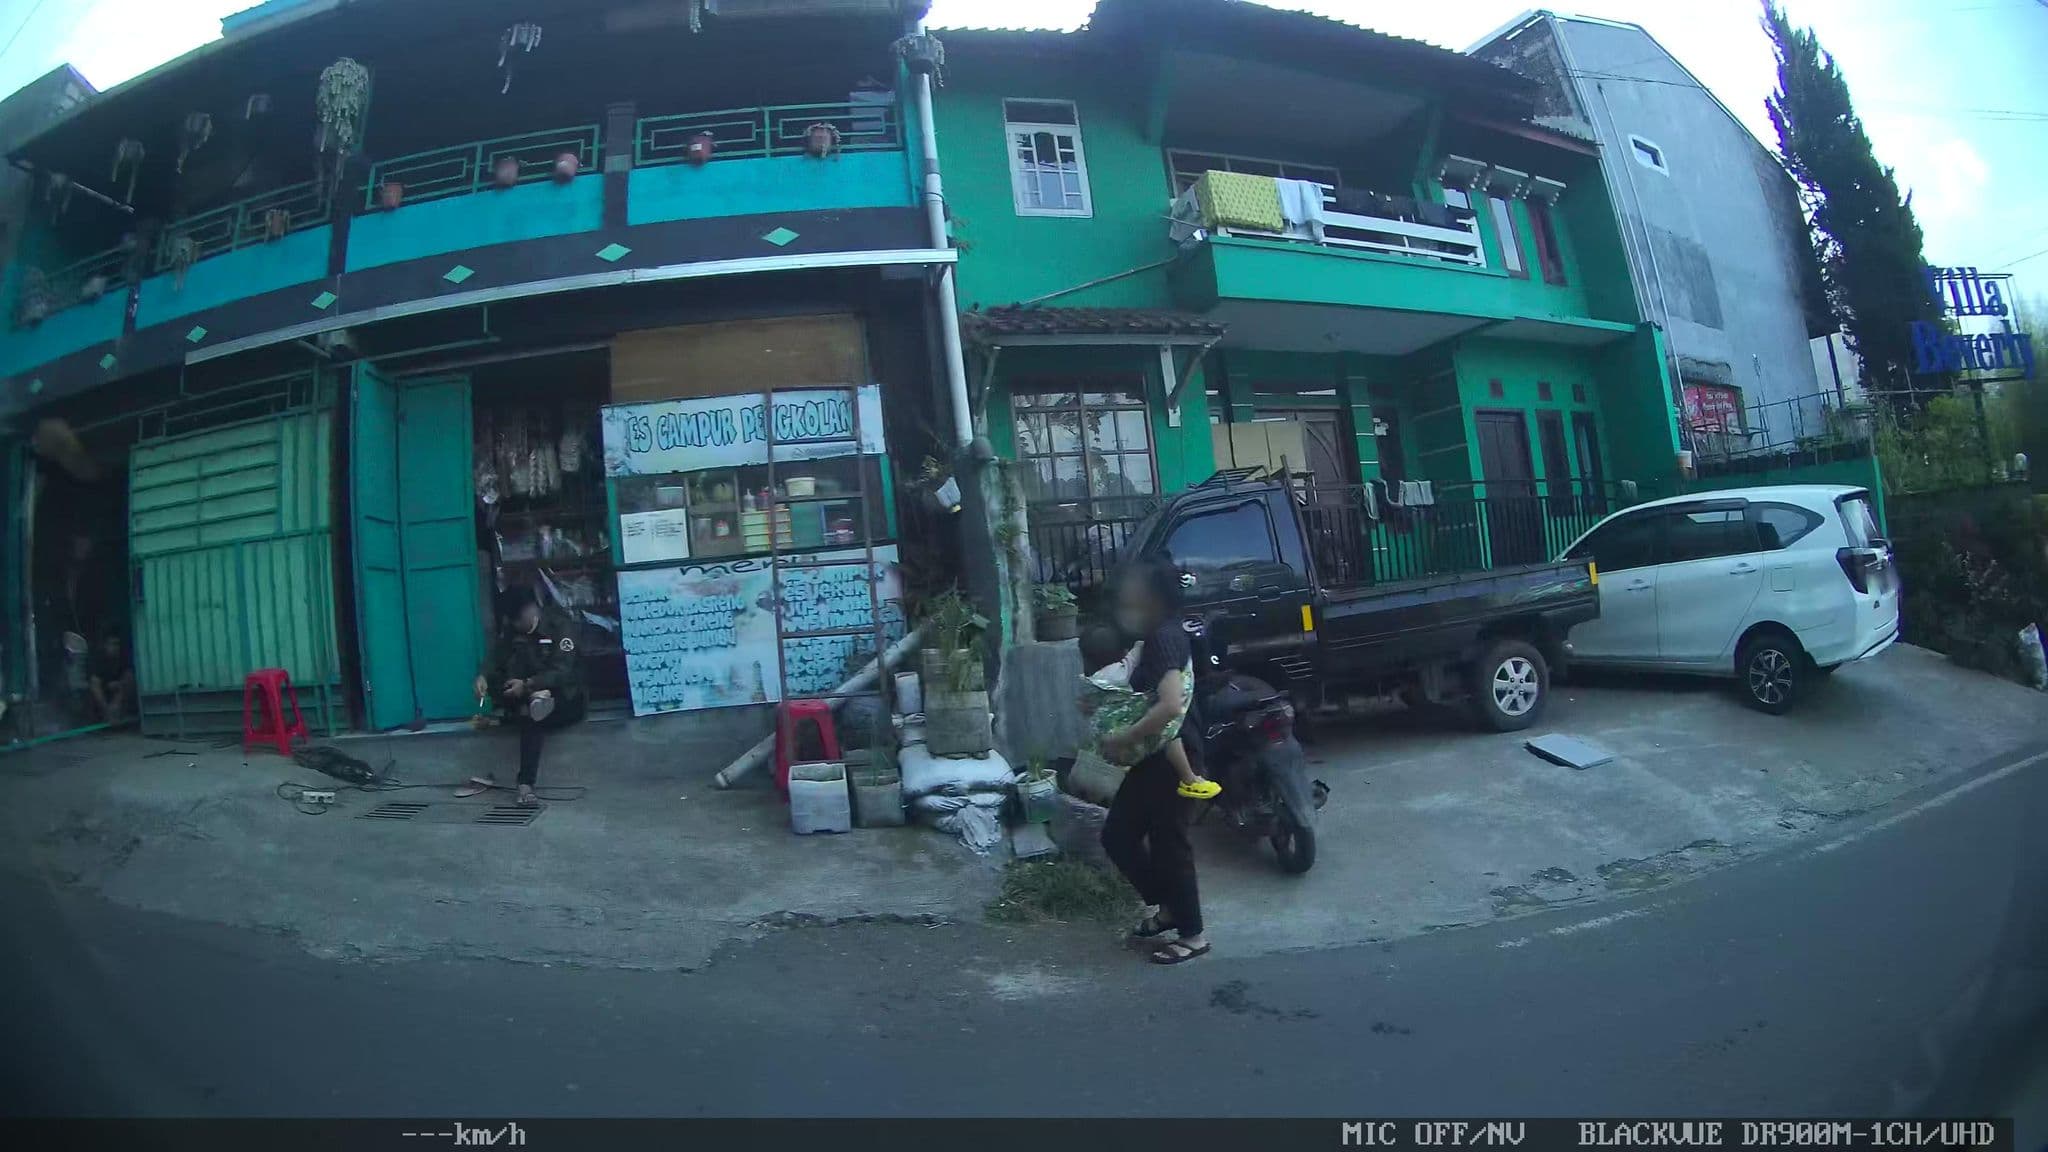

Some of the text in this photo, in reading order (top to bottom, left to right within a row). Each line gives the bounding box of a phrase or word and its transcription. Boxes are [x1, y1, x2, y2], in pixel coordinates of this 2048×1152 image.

[1927, 266, 2009, 317] Villa
[629, 415, 652, 453] ES
[656, 408, 738, 451] CAMPUR
